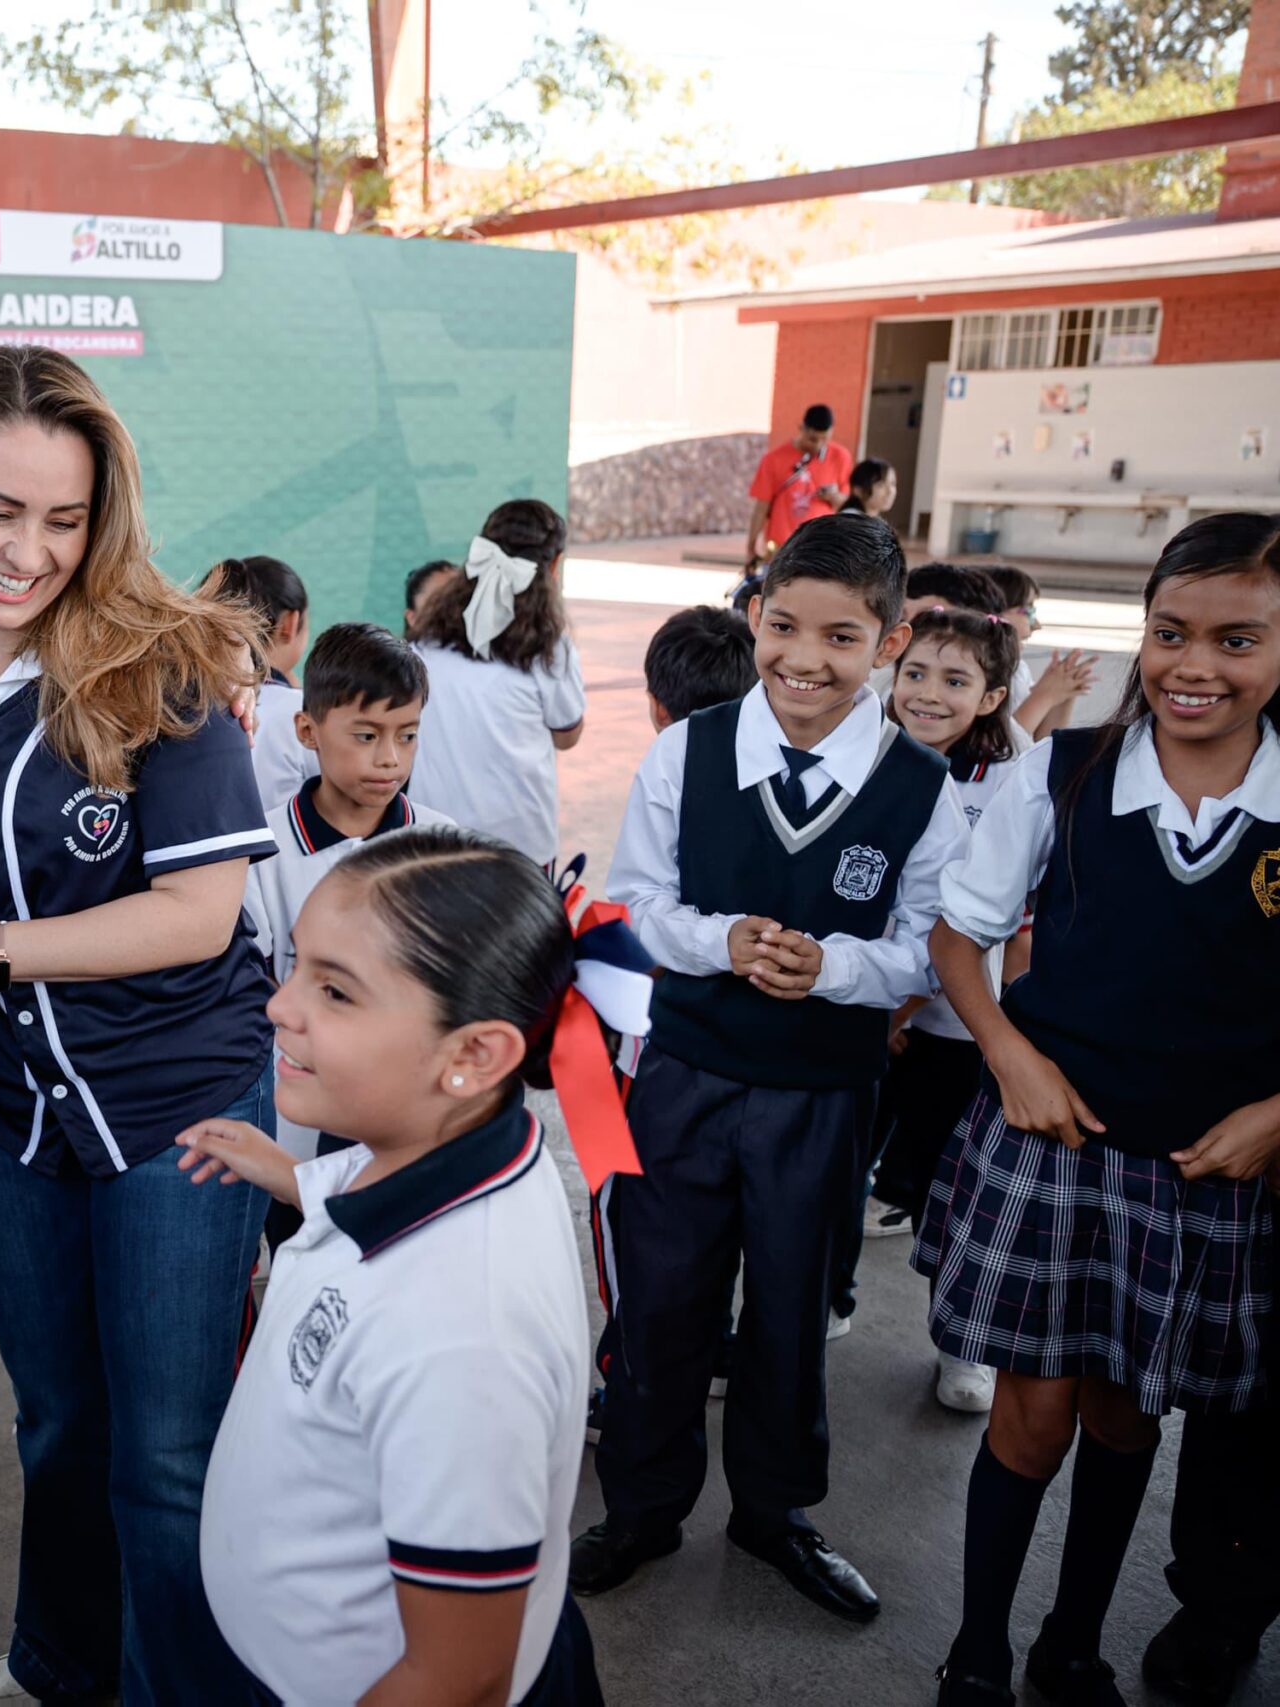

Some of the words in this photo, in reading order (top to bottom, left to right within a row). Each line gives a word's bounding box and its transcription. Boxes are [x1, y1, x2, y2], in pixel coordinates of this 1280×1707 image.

[61, 798, 77, 816] POR
[63, 835, 78, 852] POR
[73, 849, 96, 862] AMOR
[95, 853, 102, 861] A
